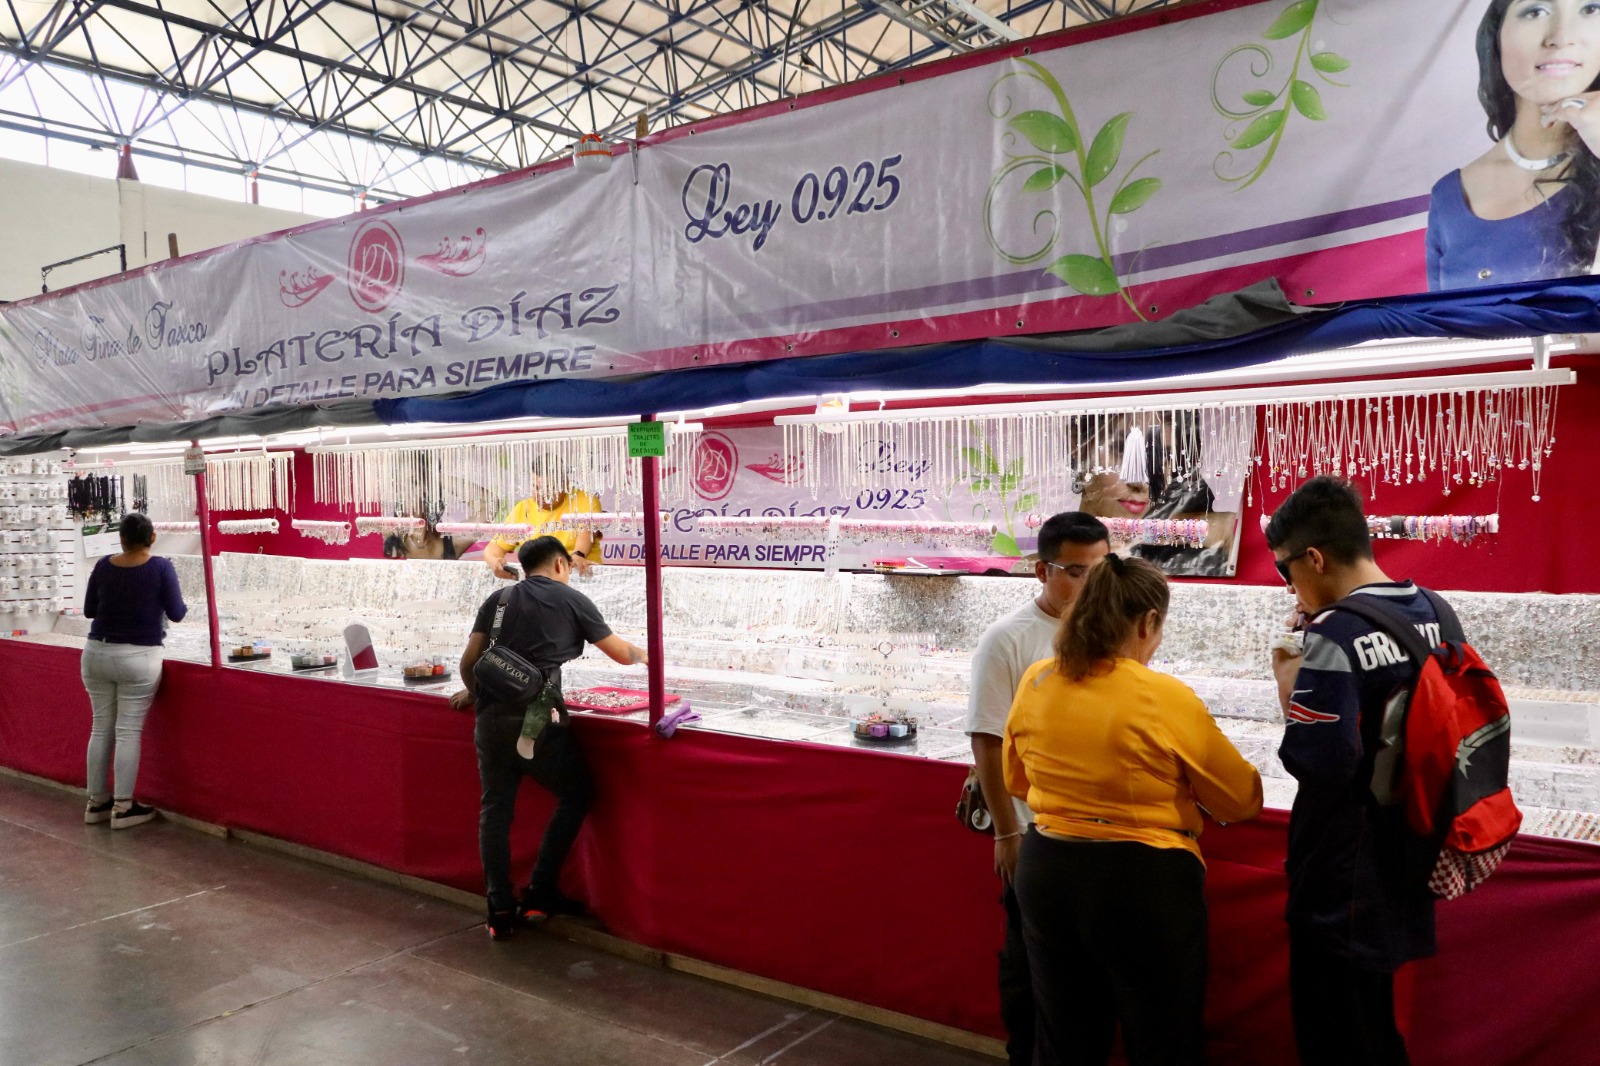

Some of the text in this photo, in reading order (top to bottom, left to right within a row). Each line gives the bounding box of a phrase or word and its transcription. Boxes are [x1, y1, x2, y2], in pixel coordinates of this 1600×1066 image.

[682, 154, 902, 251] Ley 0.925
[126, 324, 142, 355] de
[145, 301, 208, 350] Taxco
[207, 283, 620, 386] PLATERÍA DÍAZ
[253, 375, 357, 408] DETALLE
[363, 366, 437, 395] PARA
[444, 345, 597, 385] SIEMPRE
[856, 488, 928, 510] 0.925
[603, 544, 826, 562] UN DEALLE PARA SIEMPR
